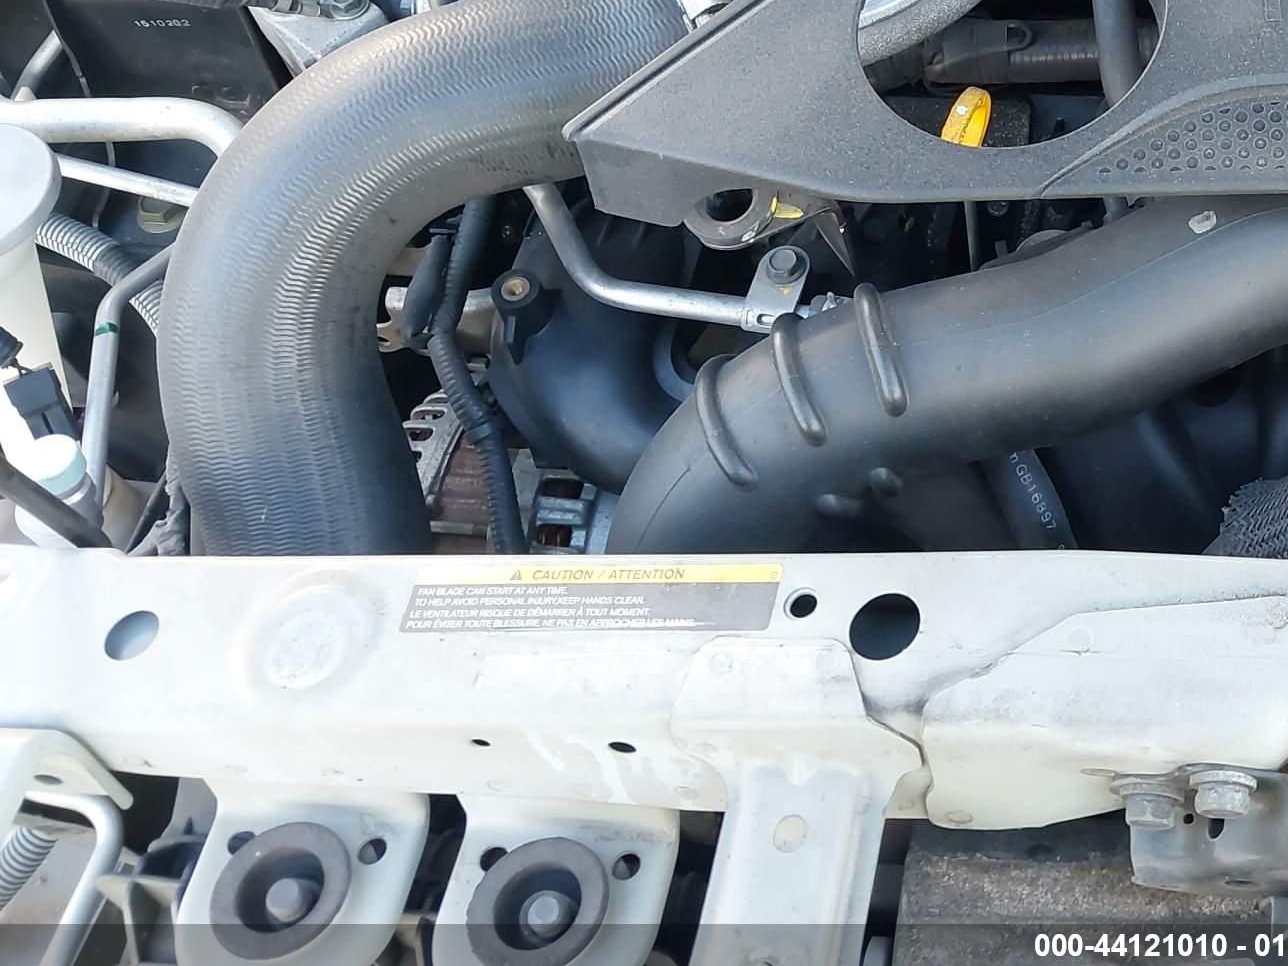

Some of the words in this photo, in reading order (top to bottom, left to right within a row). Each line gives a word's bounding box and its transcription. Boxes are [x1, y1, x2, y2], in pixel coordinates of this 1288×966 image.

[1015, 463, 1057, 530] GB16897
[532, 569, 594, 581] CAUTION
[607, 568, 686, 580] ATTENTION
[417, 587, 436, 596] FAN
[436, 587, 465, 596] BLADE
[465, 587, 485, 596] CAN
[485, 586, 514, 595] START
[513, 586, 526, 595] AT
[526, 586, 547, 595] ANY
[546, 586, 568, 595] TIME.
[415, 597, 427, 607] TO
[427, 597, 452, 606] HELP
[451, 597, 478, 606] AVOID
[479, 597, 526, 606] PERSONAL
[581, 596, 612, 605] HANDS
[409, 609, 421, 618] LE
[421, 609, 479, 618] VENTILATEUR
[479, 609, 512, 618] RISQUE
[512, 608, 527, 617] DE
[526, 606, 577, 617] DÉMARRER
[585, 608, 610, 616] TOUT
[406, 620, 433, 629] POUR
[463, 620, 494, 629] TOUTE
[542, 619, 556, 627] NE
[555, 619, 576, 627] PAS
[575, 619, 590, 627] EN
